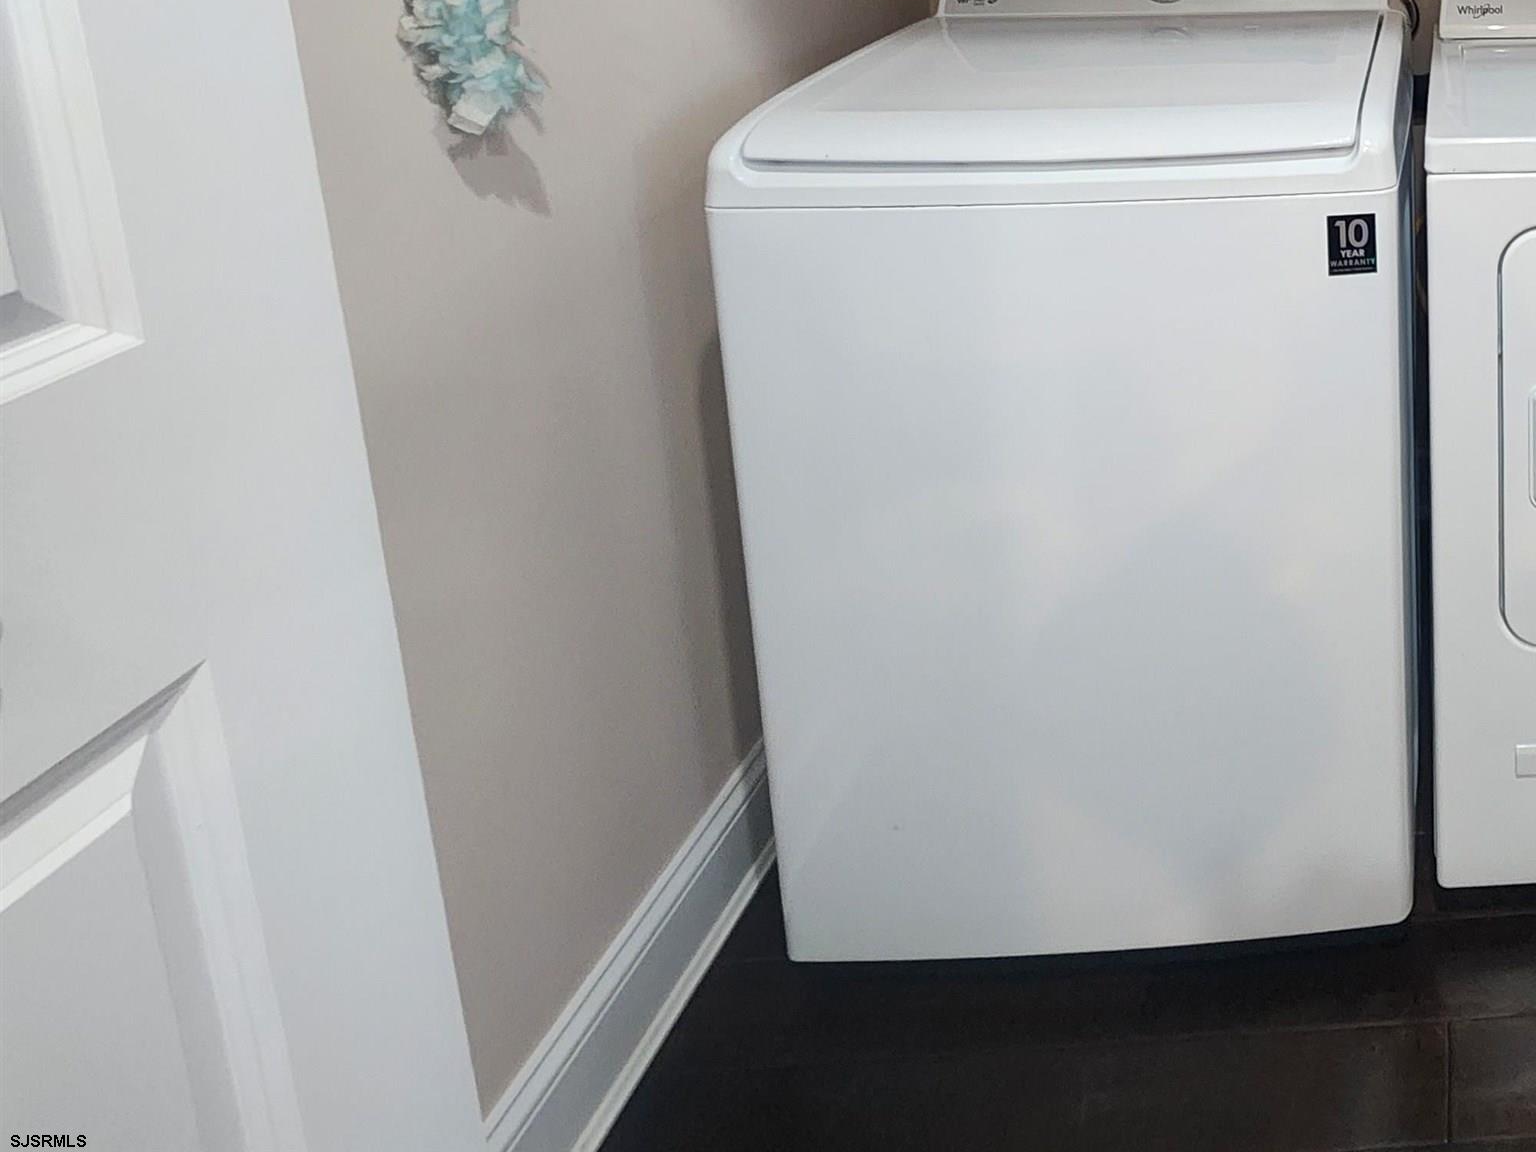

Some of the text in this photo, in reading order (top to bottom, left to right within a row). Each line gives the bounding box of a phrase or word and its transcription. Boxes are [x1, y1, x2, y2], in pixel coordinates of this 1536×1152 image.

[1456, 3, 1503, 18] Whirlpool
[1334, 218, 1369, 248] 10
[1340, 248, 1366, 258] YEAR
[1330, 258, 1375, 267] WARRANTY
